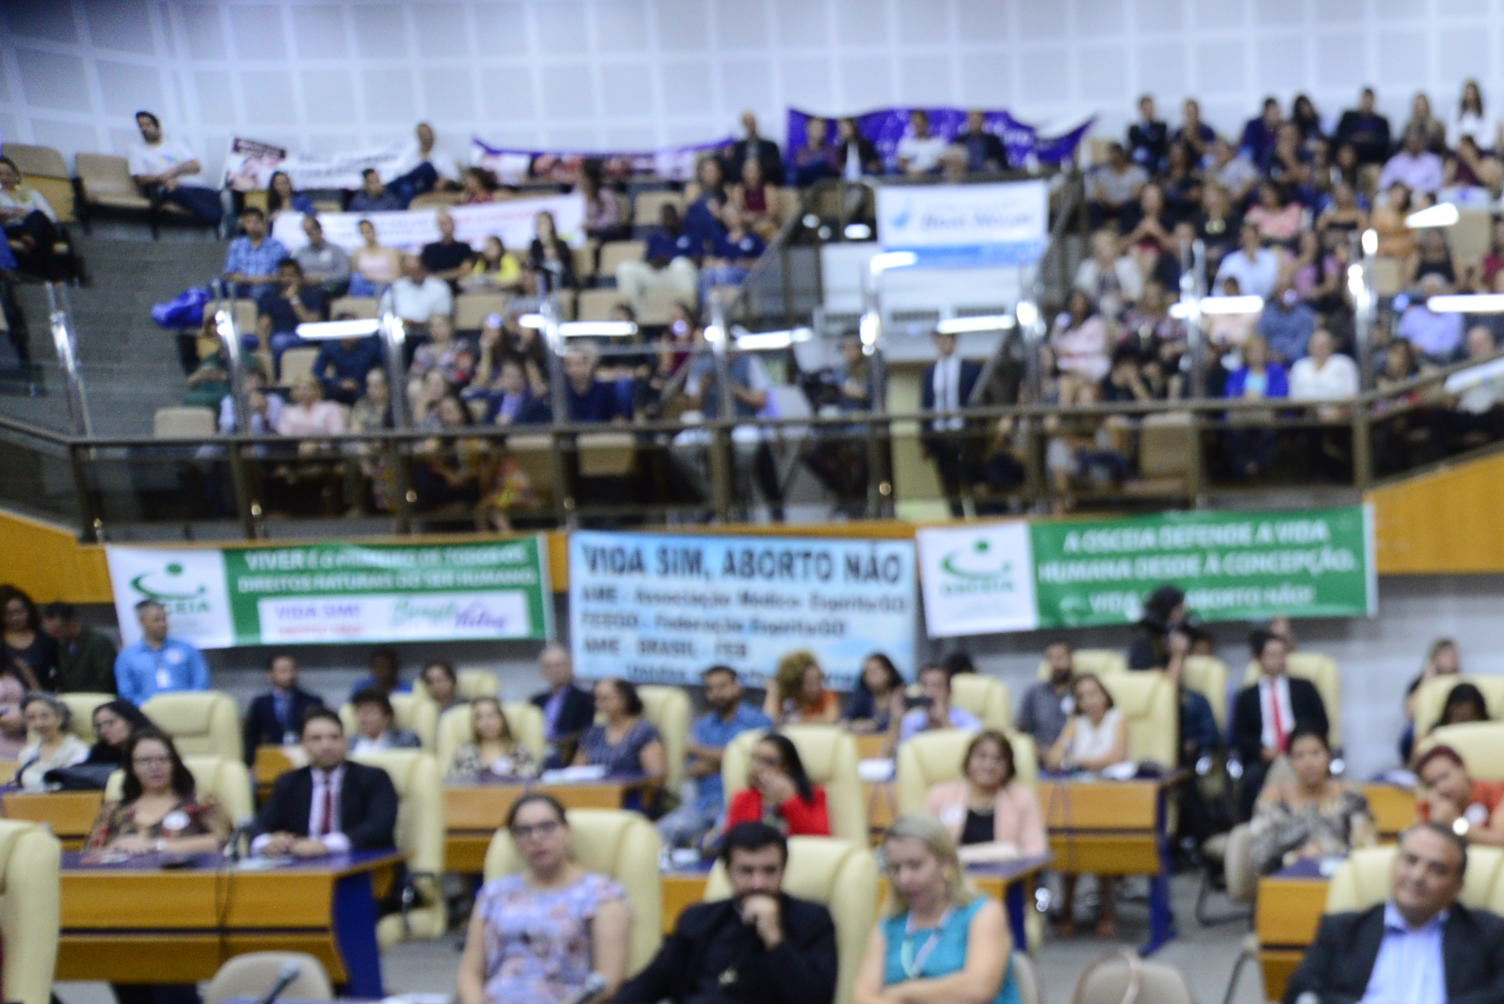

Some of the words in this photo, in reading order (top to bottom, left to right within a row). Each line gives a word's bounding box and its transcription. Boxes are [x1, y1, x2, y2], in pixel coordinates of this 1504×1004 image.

[1064, 530, 1079, 553] A
[1159, 523, 1252, 549] DEFENDE
[1256, 522, 1274, 545] A
[1275, 519, 1331, 544] VIDA
[245, 550, 304, 571] VIVER
[581, 544, 645, 575] VIDA
[721, 549, 832, 582] ABORTO
[845, 541, 902, 584] NÃO
[1038, 557, 1131, 583] HUMANA
[1135, 554, 1201, 579] DESDE
[237, 573, 312, 594] DIREITOS
